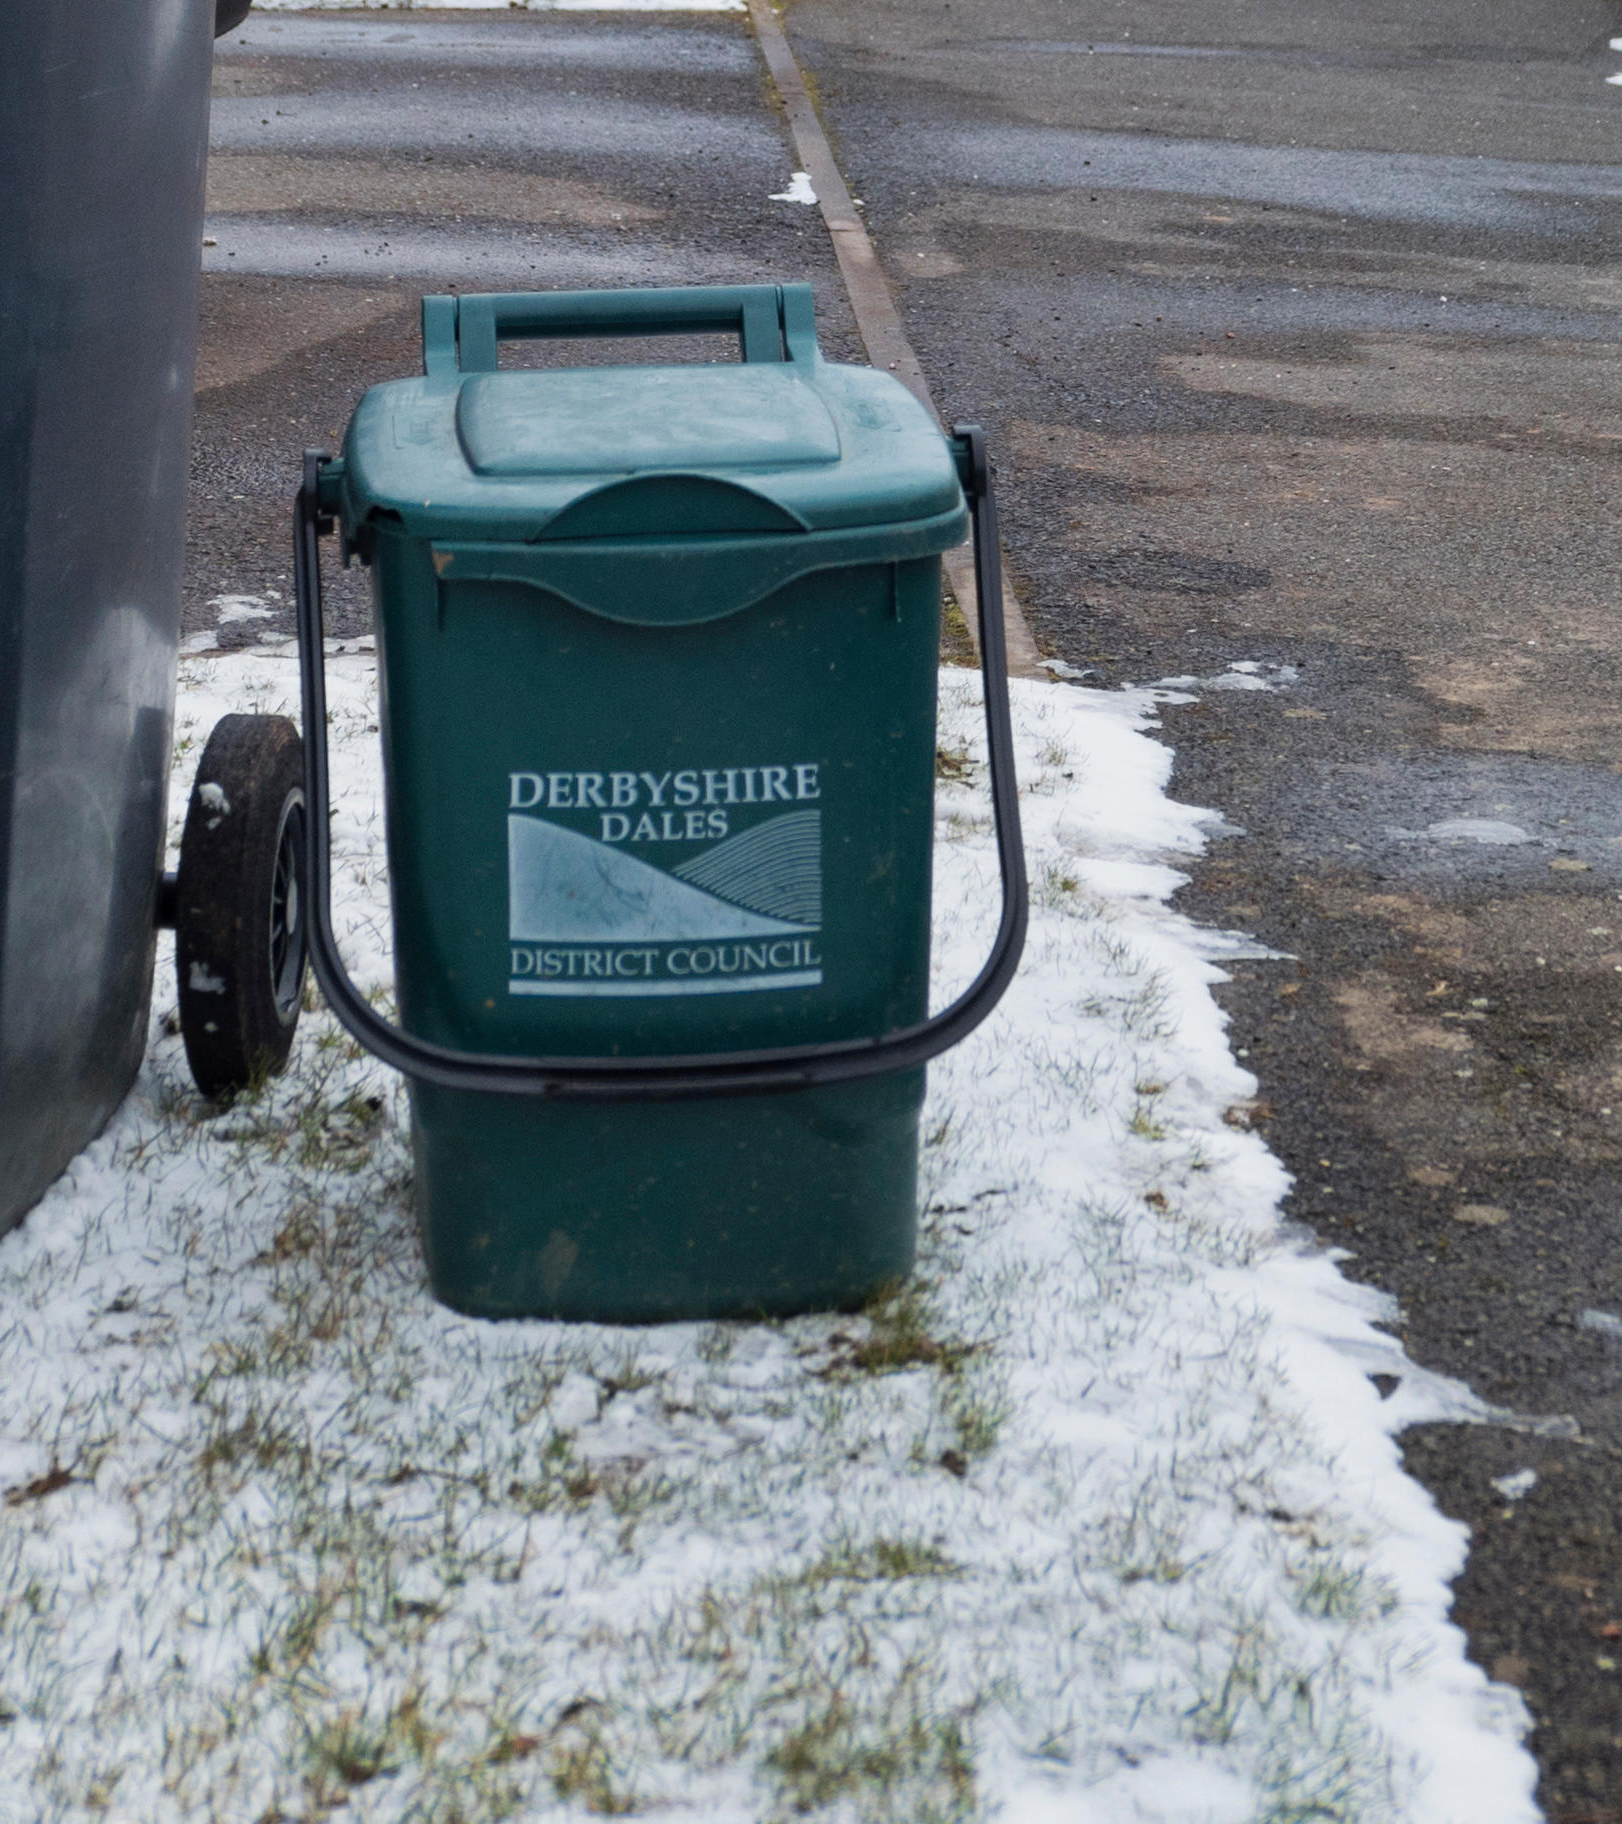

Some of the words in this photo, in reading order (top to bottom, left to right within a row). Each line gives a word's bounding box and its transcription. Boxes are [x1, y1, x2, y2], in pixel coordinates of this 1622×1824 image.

[508, 763, 822, 809] DERBYSHIRE
[600, 808, 729, 843] DALES
[510, 947, 660, 976] DISTRICT
[667, 939, 822, 976] COUNCIL
